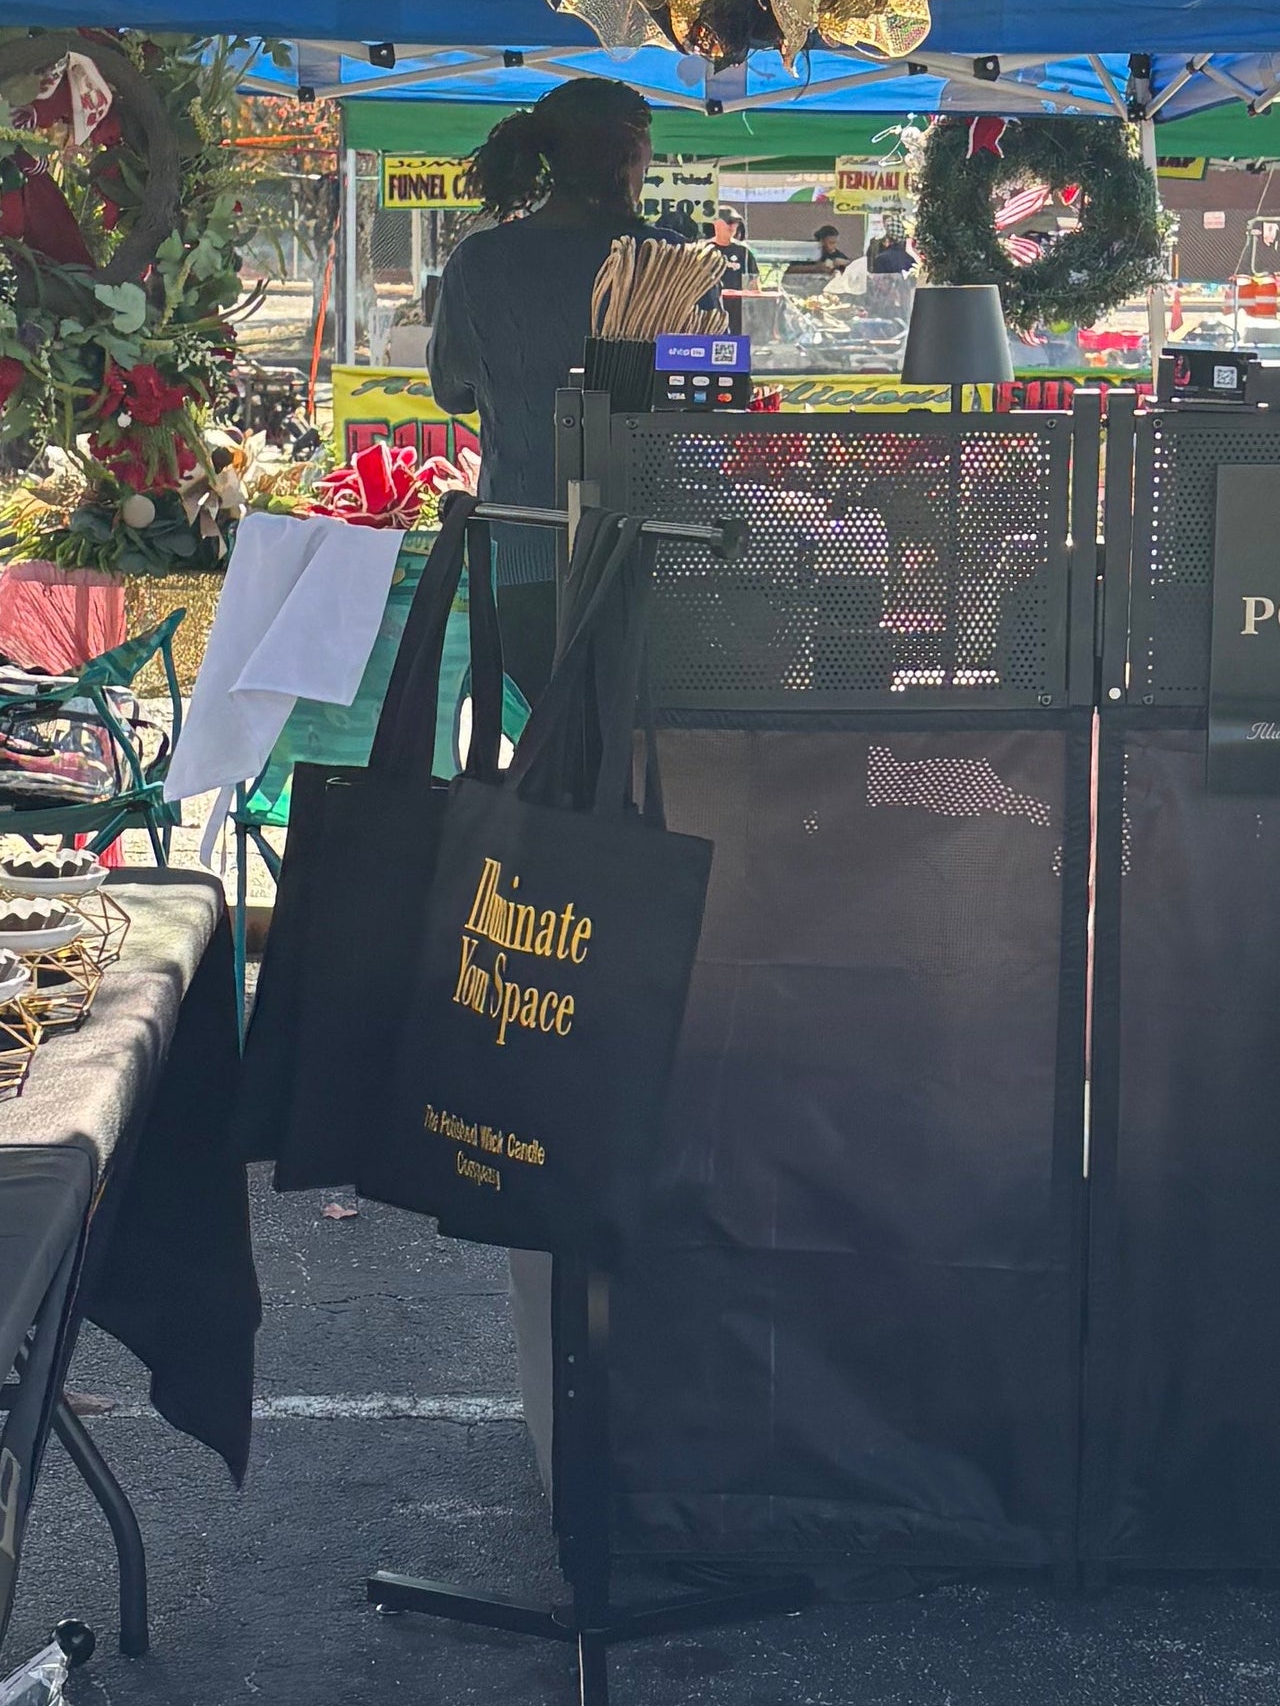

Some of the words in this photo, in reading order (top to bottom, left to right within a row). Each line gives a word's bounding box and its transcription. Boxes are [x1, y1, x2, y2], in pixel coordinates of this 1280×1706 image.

[389, 174, 447, 200] FUNNEL
[464, 857, 592, 964] Illuminate
[490, 952, 575, 1045] Space
[507, 1133, 545, 1165] Candle
